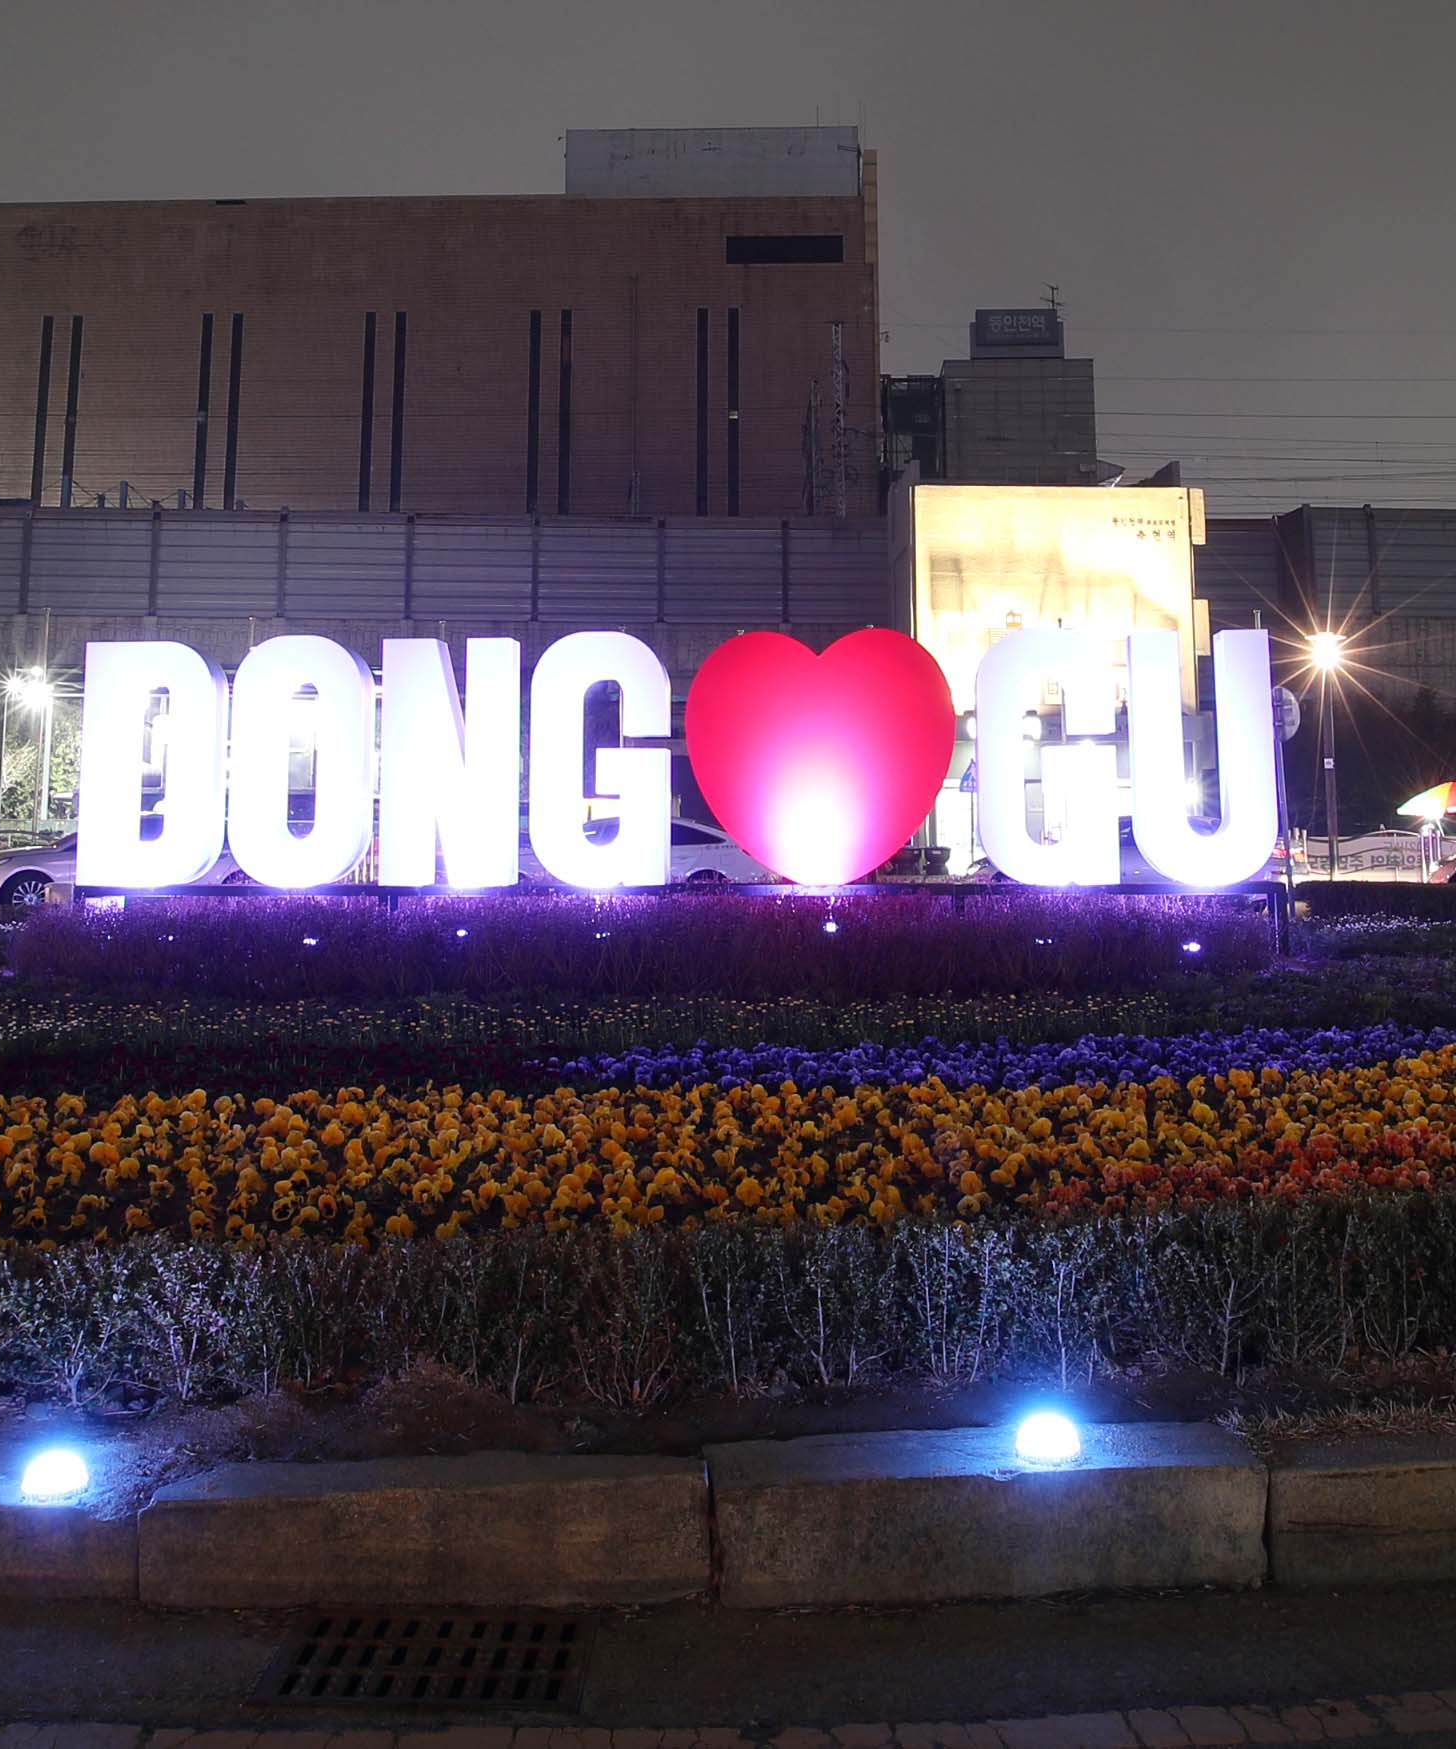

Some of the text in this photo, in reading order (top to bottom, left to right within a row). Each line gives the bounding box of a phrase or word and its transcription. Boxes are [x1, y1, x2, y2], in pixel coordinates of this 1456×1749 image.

[988, 314, 1046, 333] 동인천역
[76, 628, 1279, 891] DONG GU
